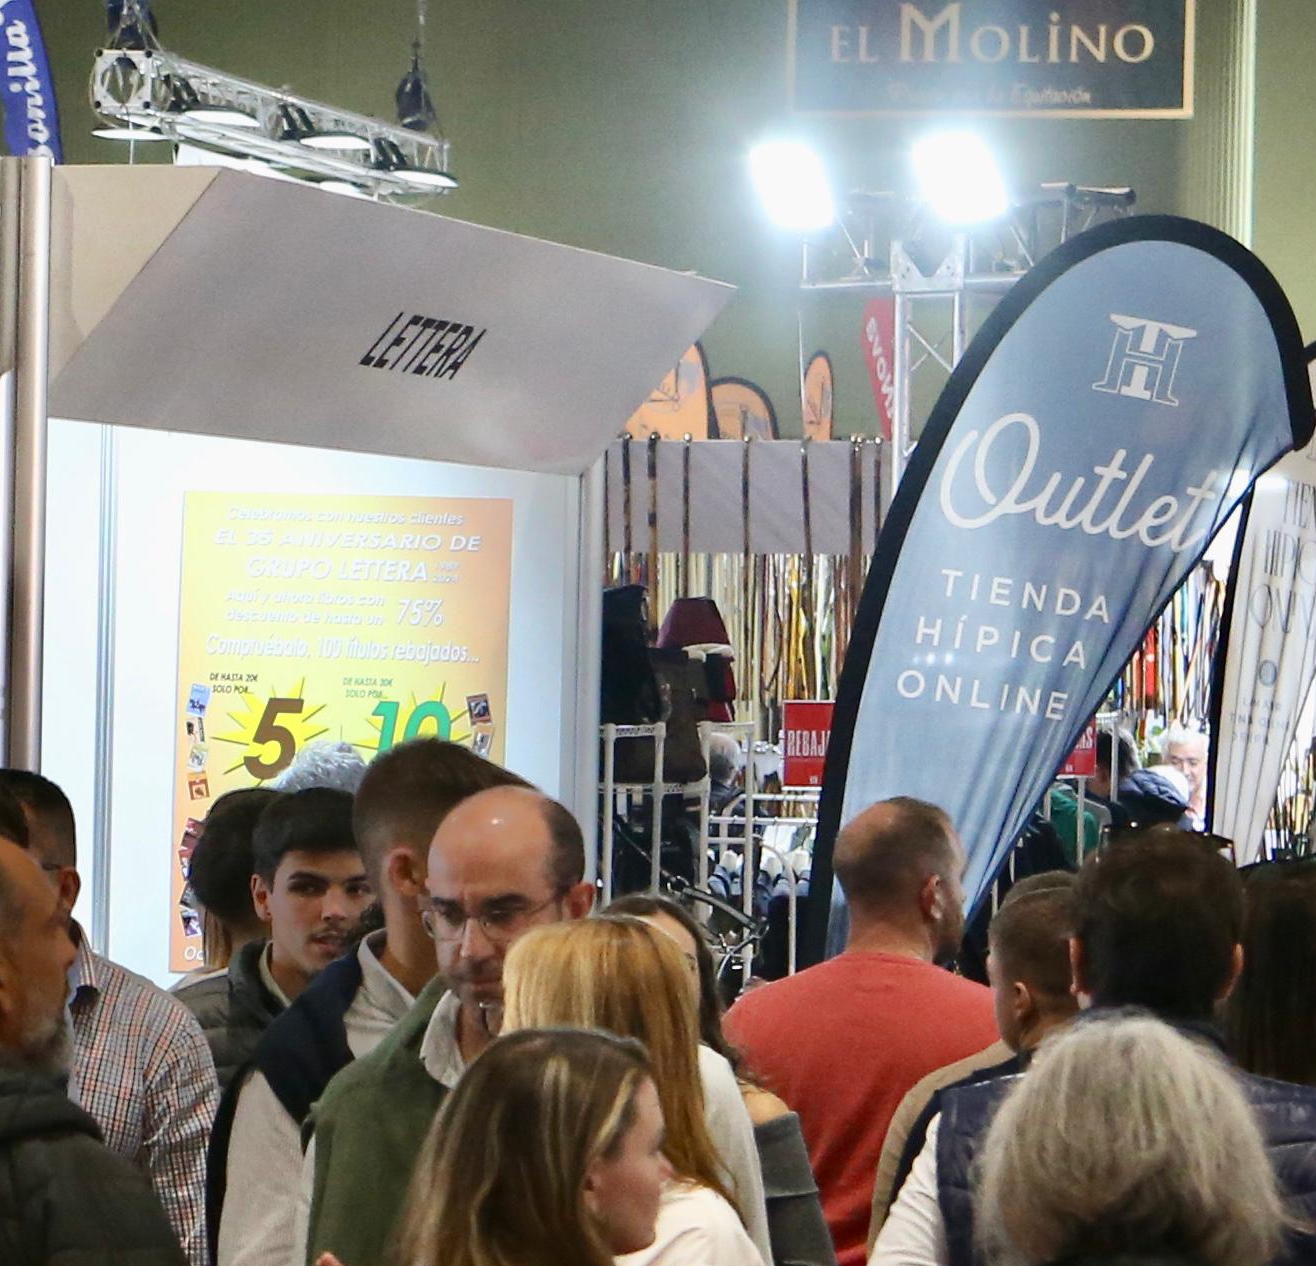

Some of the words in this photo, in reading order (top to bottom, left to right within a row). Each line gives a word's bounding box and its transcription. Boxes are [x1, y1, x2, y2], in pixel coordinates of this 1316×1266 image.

[831, 26, 879, 64] EL
[359, 312, 487, 381] LETTERA
[940, 412, 1220, 553] Outlet
[317, 511, 343, 523] con
[347, 510, 405, 525] nuestros
[409, 511, 464, 526] clientes
[215, 529, 237, 545] EL
[245, 530, 273, 546] 35
[279, 532, 443, 552] ANIVERSARIO
[449, 535, 481, 552] DE
[247, 556, 333, 579] GRUPO
[338, 558, 429, 582] LETTERA
[941, 570, 1110, 624] TIENDA
[301, 610, 321, 624] de
[324, 612, 362, 626] hasta
[367, 614, 383, 626] un
[397, 599, 445, 627] 75%
[391, 640, 480, 667] rebajados...
[915, 616, 1085, 670] HÍPICA
[209, 672, 221, 682] DE
[221, 672, 243, 682] HASTA
[213, 685, 232, 694] SOLO
[343, 678, 355, 686] DE
[357, 678, 378, 687] HASTA
[345, 689, 366, 698] SOLO
[897, 670, 1068, 722] ONLINE
[243, 697, 305, 780] 5
